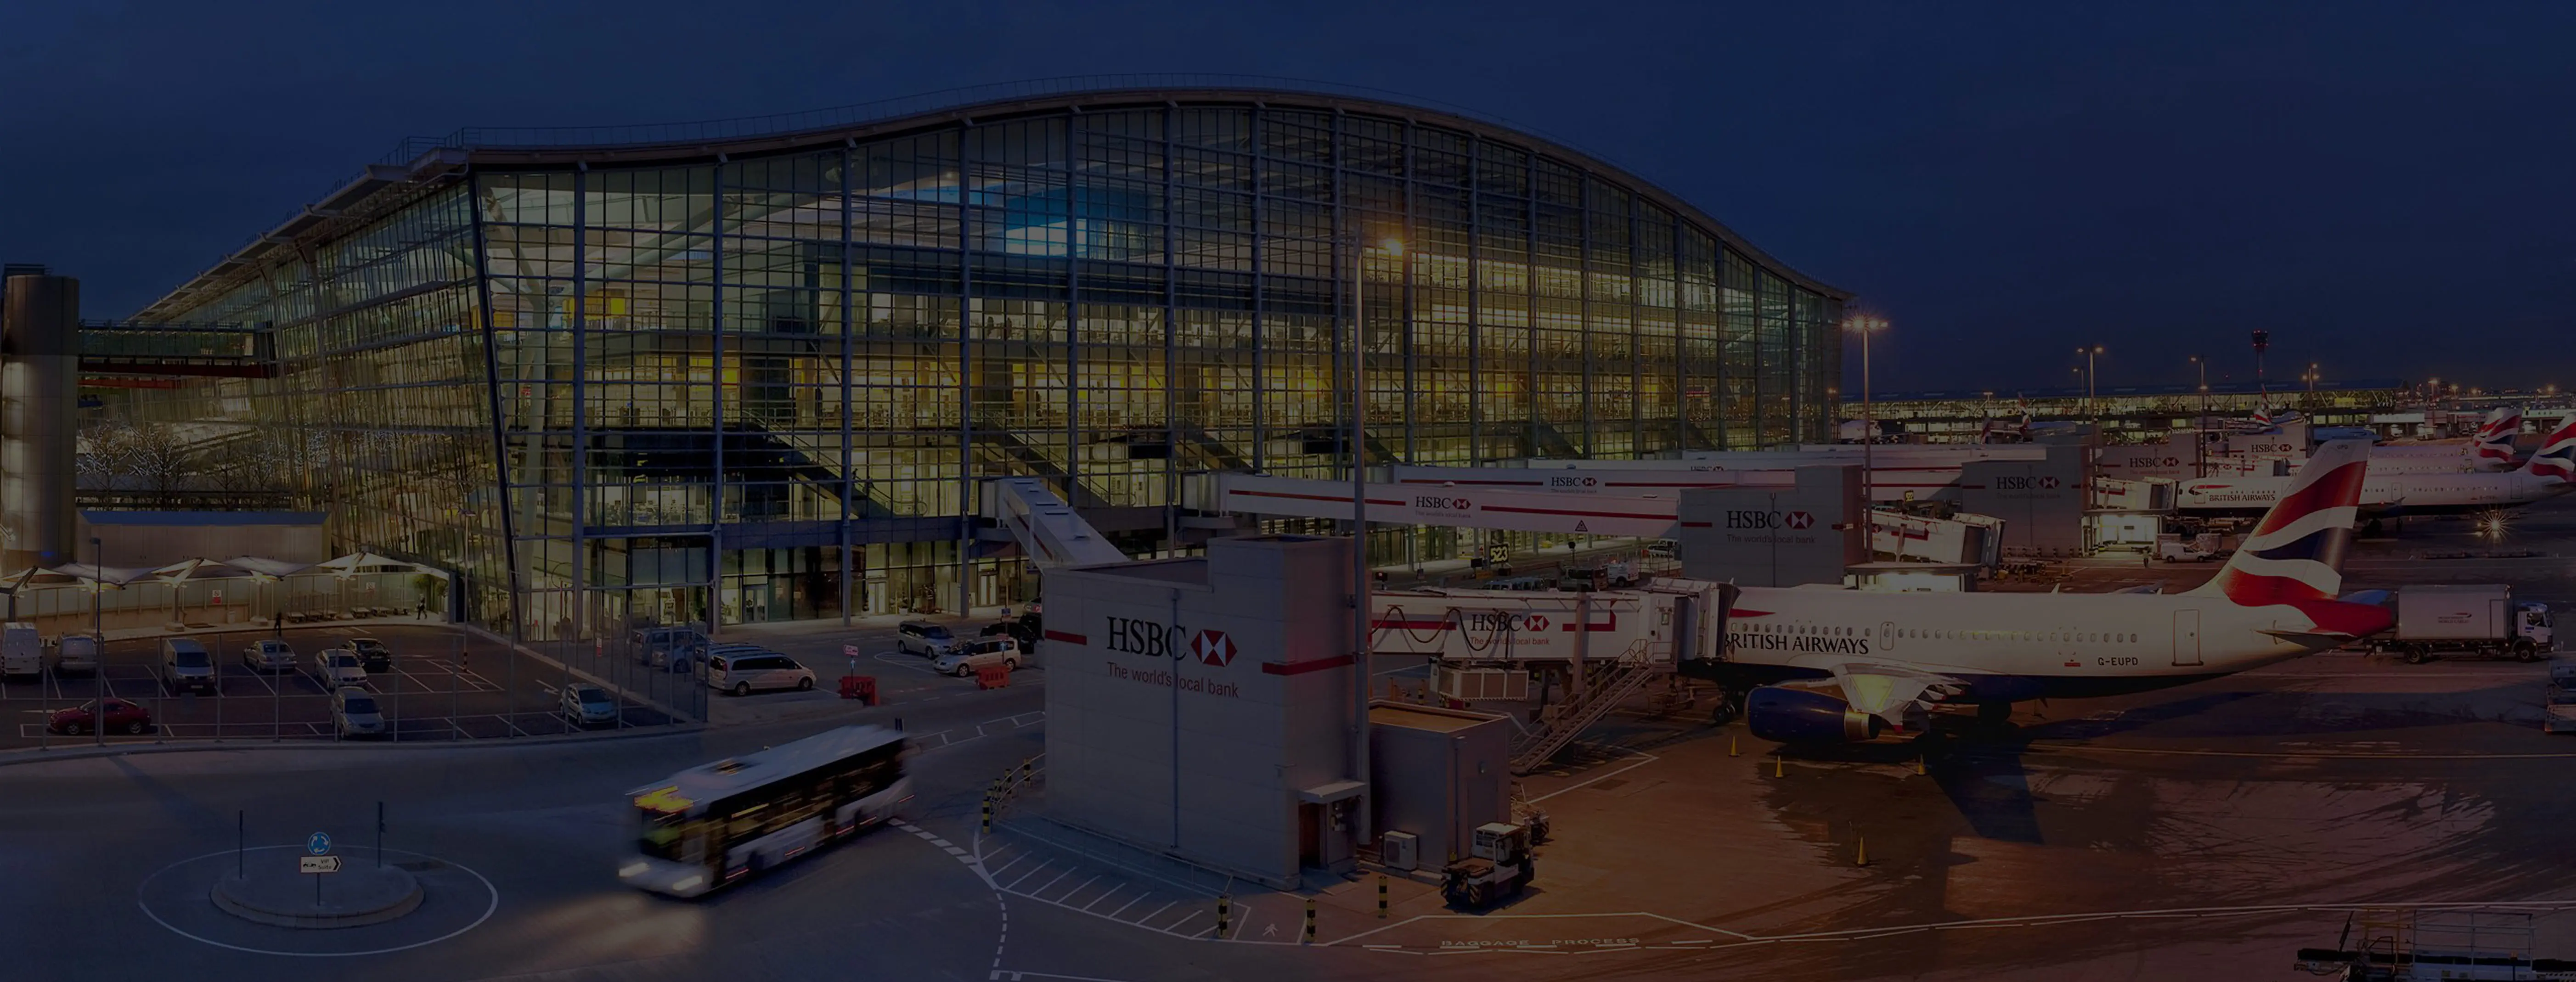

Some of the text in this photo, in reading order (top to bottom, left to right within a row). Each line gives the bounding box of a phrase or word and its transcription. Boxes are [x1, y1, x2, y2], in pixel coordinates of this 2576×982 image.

[2252, 444, 2277, 453] HSBC
[2130, 457, 2161, 467] HSBC
[1551, 477, 1580, 487] HSBC
[1996, 476, 2036, 490] HSBC
[1415, 496, 1451, 509] HSBC
[1726, 511, 1782, 529] HSBC
[1727, 534, 1742, 543] The
[1796, 535, 1816, 544] bank
[1490, 546, 1508, 562] 523
[1471, 614, 1522, 632] HSBC
[1107, 616, 1187, 661] HSBC
[1532, 637, 1550, 645] bank
[1792, 636, 1870, 655] AIRWAYS
[2097, 657, 2138, 666] G-EUPD
[1107, 662, 1239, 699] The world's local bank
